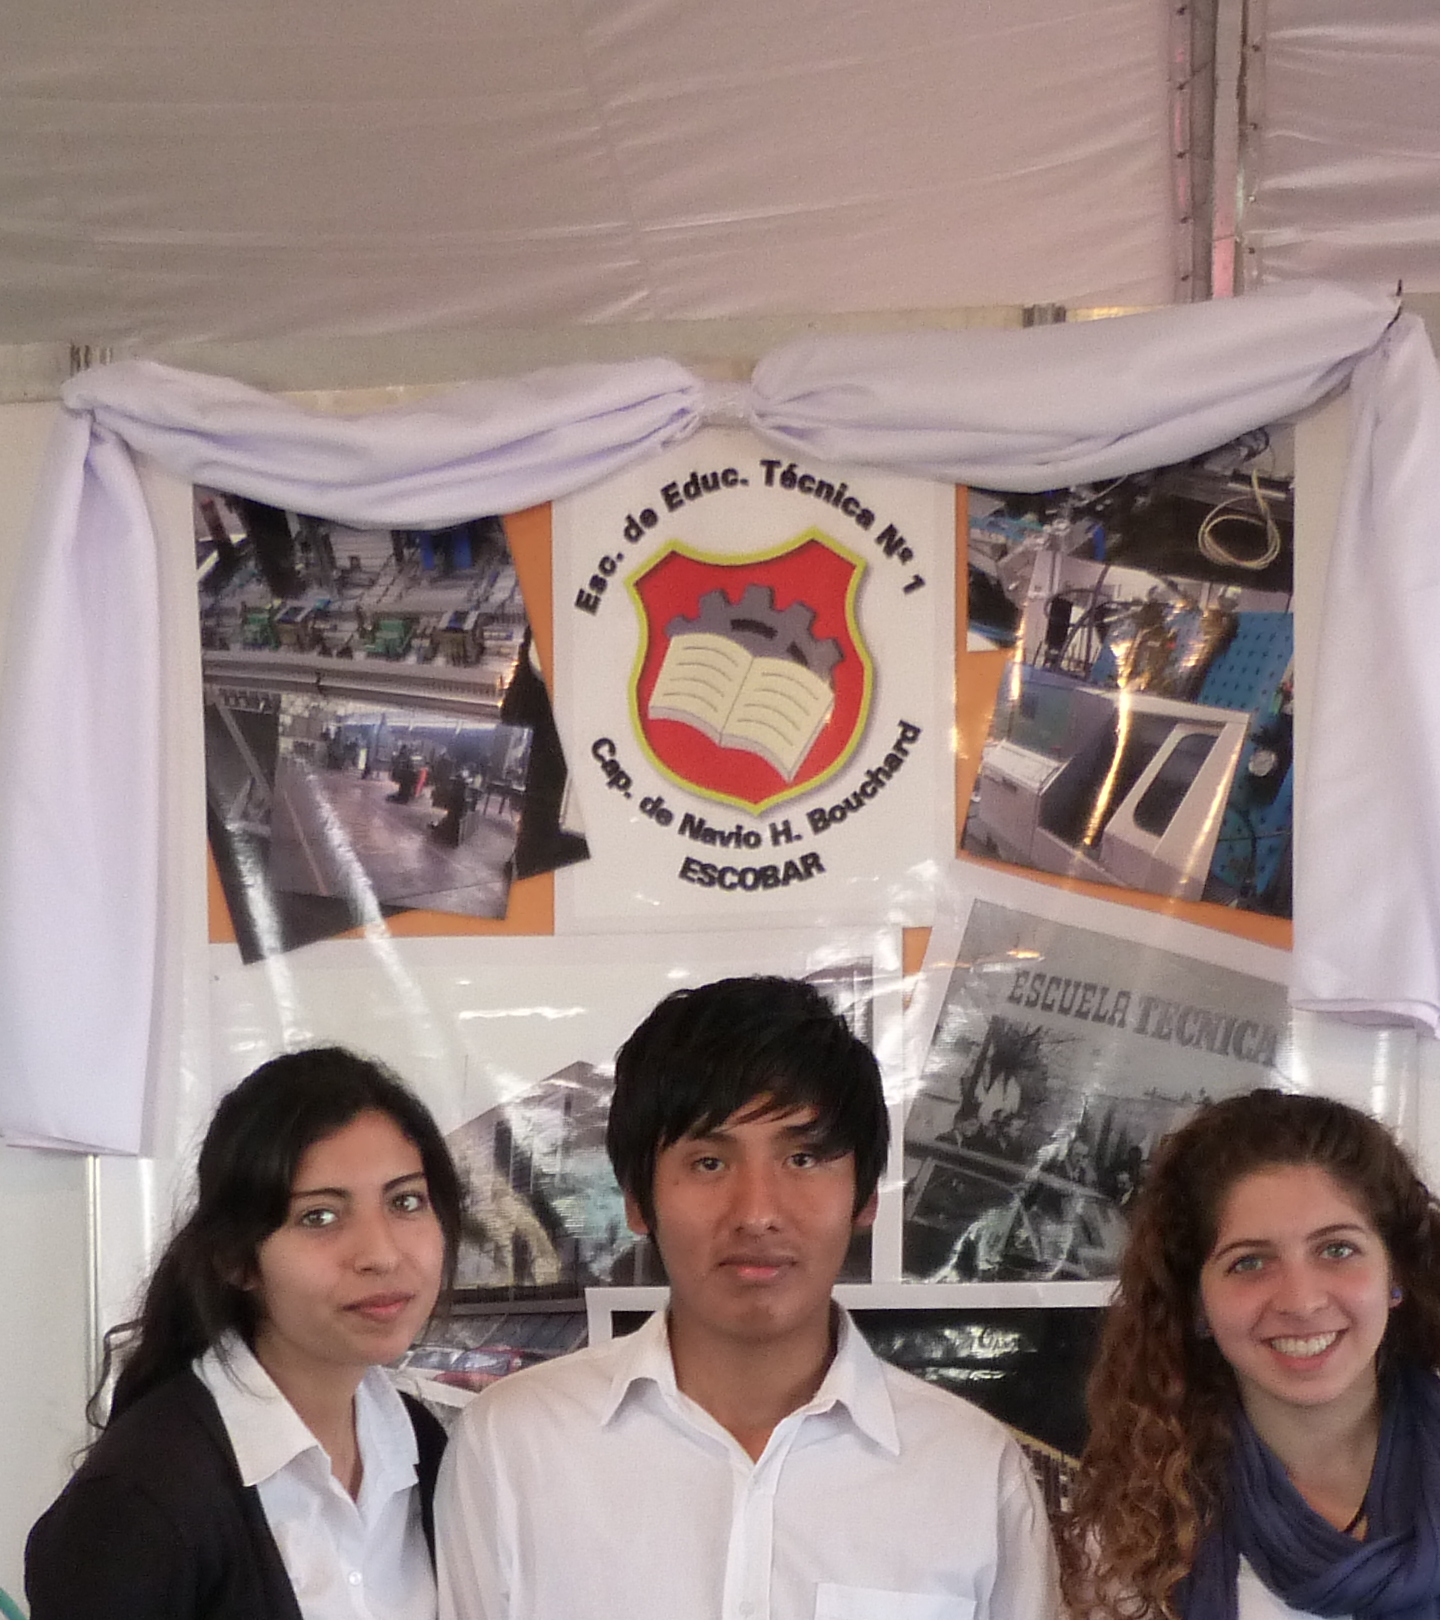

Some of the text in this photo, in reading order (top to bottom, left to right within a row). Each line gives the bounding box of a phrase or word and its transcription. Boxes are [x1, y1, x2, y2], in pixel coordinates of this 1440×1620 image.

[575, 552, 624, 616] Esc.
[623, 507, 658, 544] de
[660, 465, 749, 512] Educ.
[760, 459, 876, 531] Técnica
[903, 574, 926, 595] 1
[591, 719, 922, 850] Cap. de Navio H. Bouchard
[678, 852, 827, 892] ESCOBAR
[1006, 970, 1280, 1068] ESCUELA TECNICA
